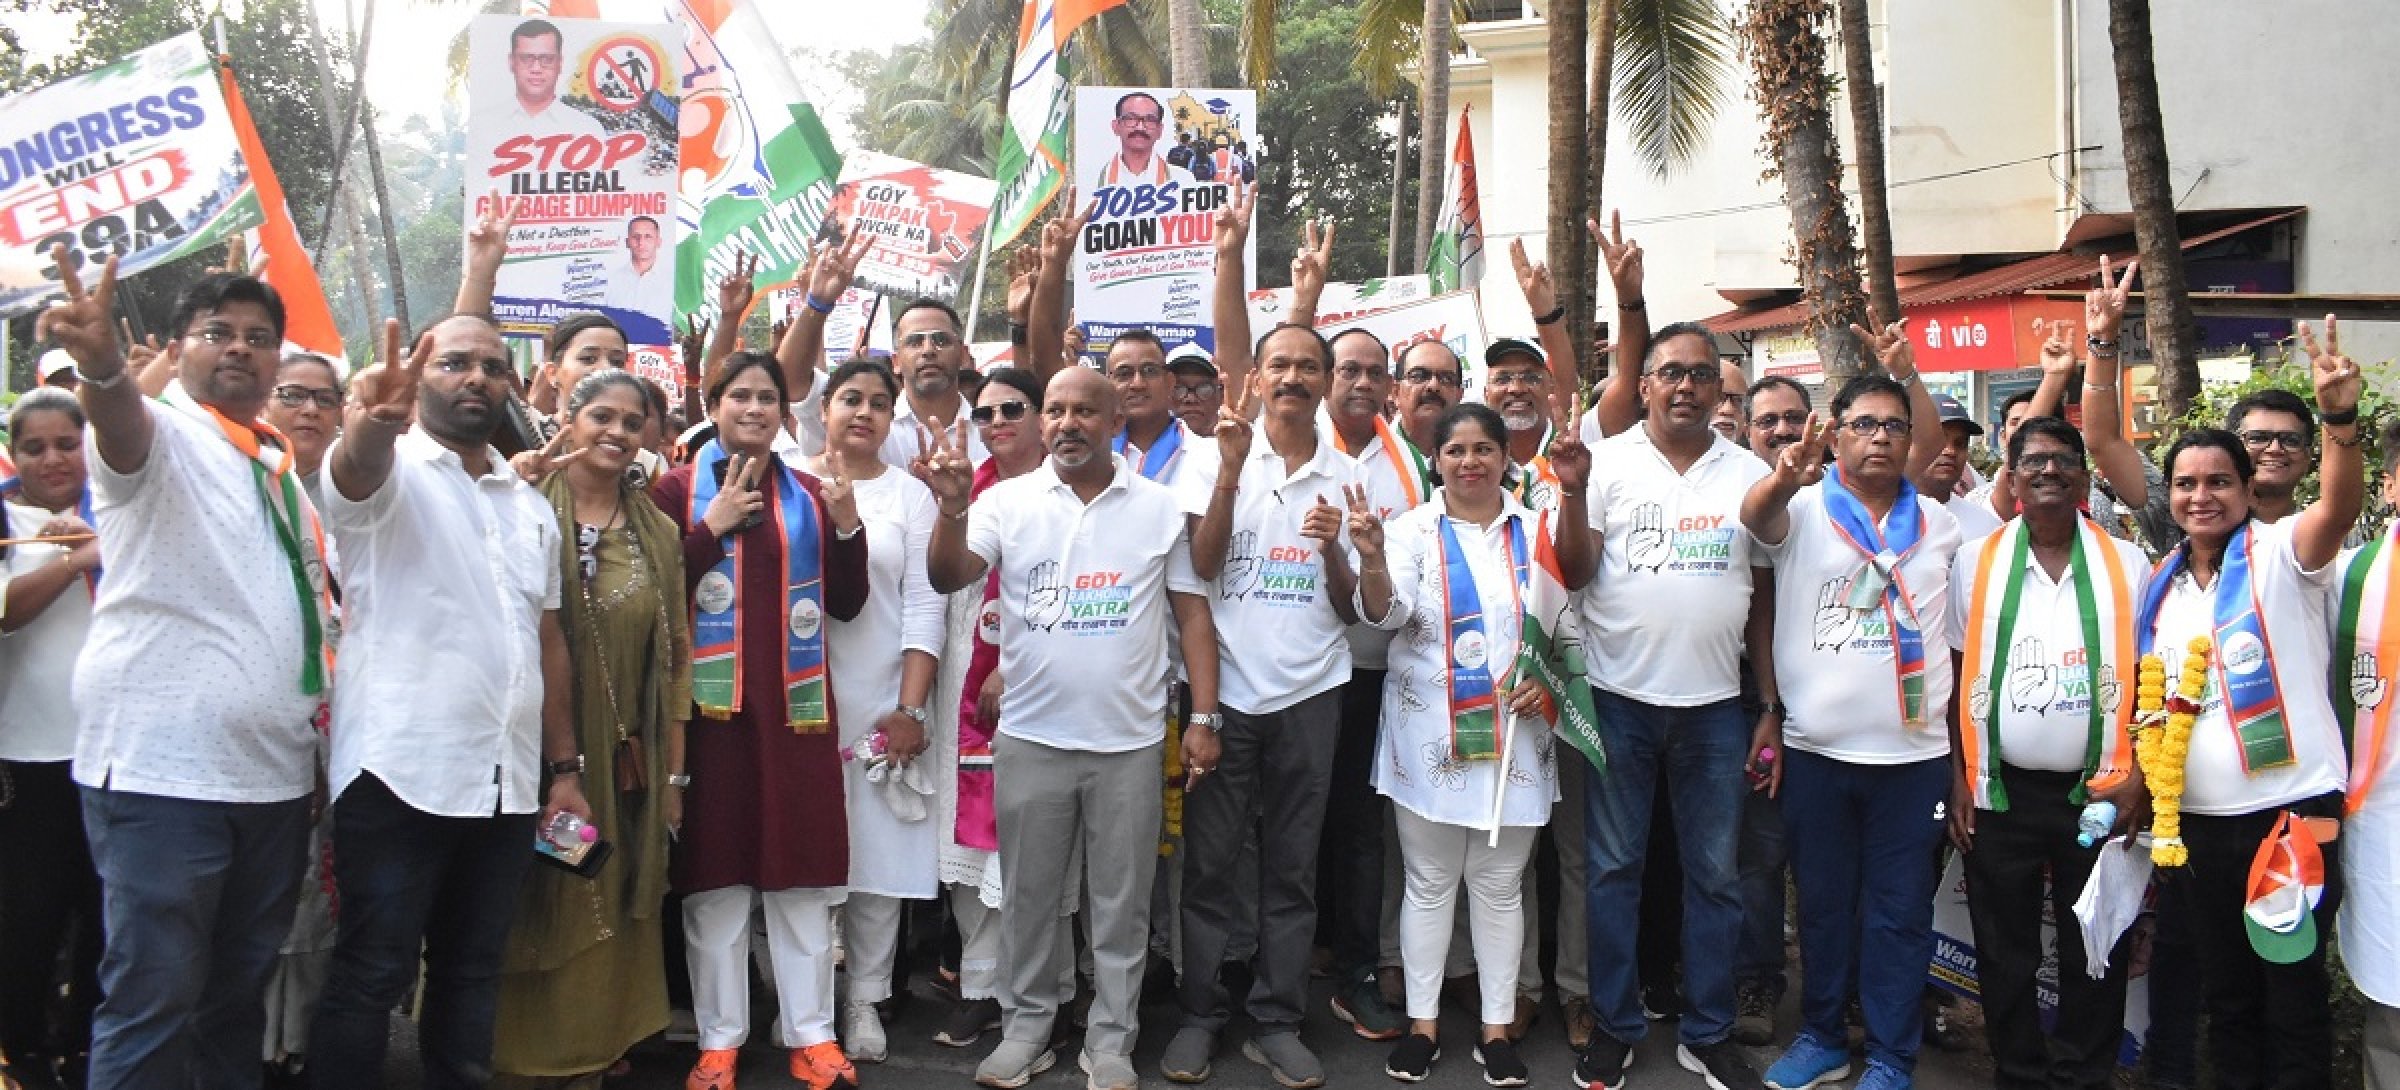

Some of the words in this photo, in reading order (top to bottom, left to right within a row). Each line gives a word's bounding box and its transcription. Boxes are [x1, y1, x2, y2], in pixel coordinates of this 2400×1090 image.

[0, 85, 206, 190] ONGRESS
[45, 151, 124, 187] WILL
[488, 133, 647, 178] STOP
[511, 170, 626, 195] ILLEGAL
[13, 156, 175, 241] END
[574, 192, 667, 217] DUMPING
[1089, 180, 1180, 223] JOBS
[1181, 184, 1228, 212] FOR
[34, 198, 187, 280] 39A
[1084, 217, 1157, 254] GOAN
[1160, 212, 1214, 245] YOU
[493, 302, 537, 317] arren
[1089, 325, 1131, 337] Warr
[1143, 325, 1197, 338] lemao
[1677, 543, 1729, 560] YATRA
[1263, 576, 1315, 591] YATRA
[1071, 602, 1129, 618] YATRA
